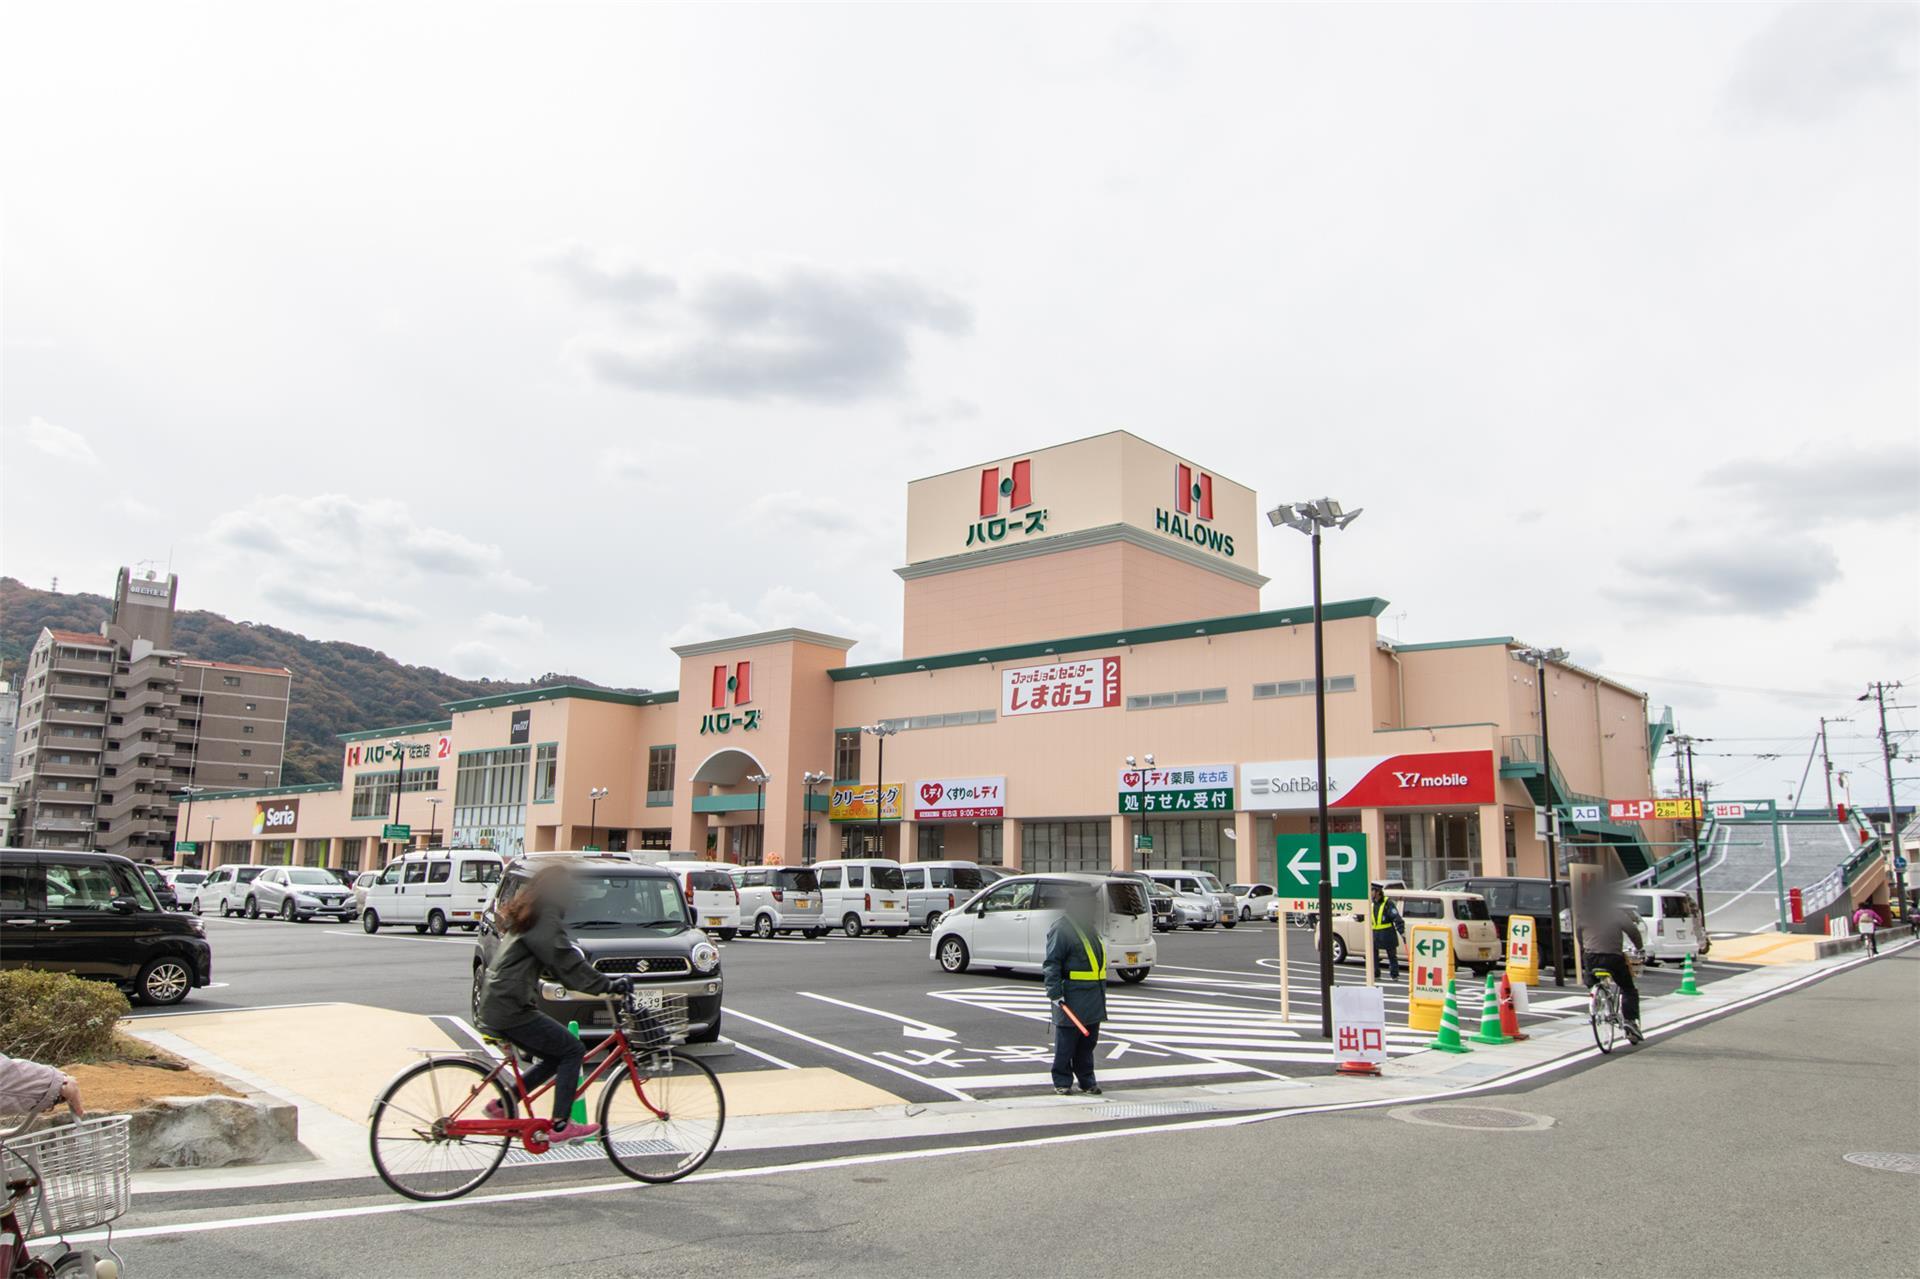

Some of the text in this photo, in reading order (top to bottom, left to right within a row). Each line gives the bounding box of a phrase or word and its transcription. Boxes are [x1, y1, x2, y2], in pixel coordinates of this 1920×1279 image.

[965, 510, 1047, 547] ハローズ
[1156, 507, 1235, 557] HALOWS
[1011, 665, 1094, 685] ファッションセンター
[1011, 680, 1094, 711] しまむら
[700, 709, 762, 735] ハローズ
[1198, 771, 1229, 784] 佐古店
[1271, 776, 1337, 793] SoftBak
[1124, 790, 1227, 811] 処方せん受付
[1716, 805, 1742, 816] 出口
[266, 804, 296, 827] Seria
[1575, 808, 1598, 819] 入口
[1329, 845, 1357, 888] P
[1520, 924, 1531, 937] P
[1431, 939, 1446, 957] P
[1338, 1026, 1382, 1052] 出口
